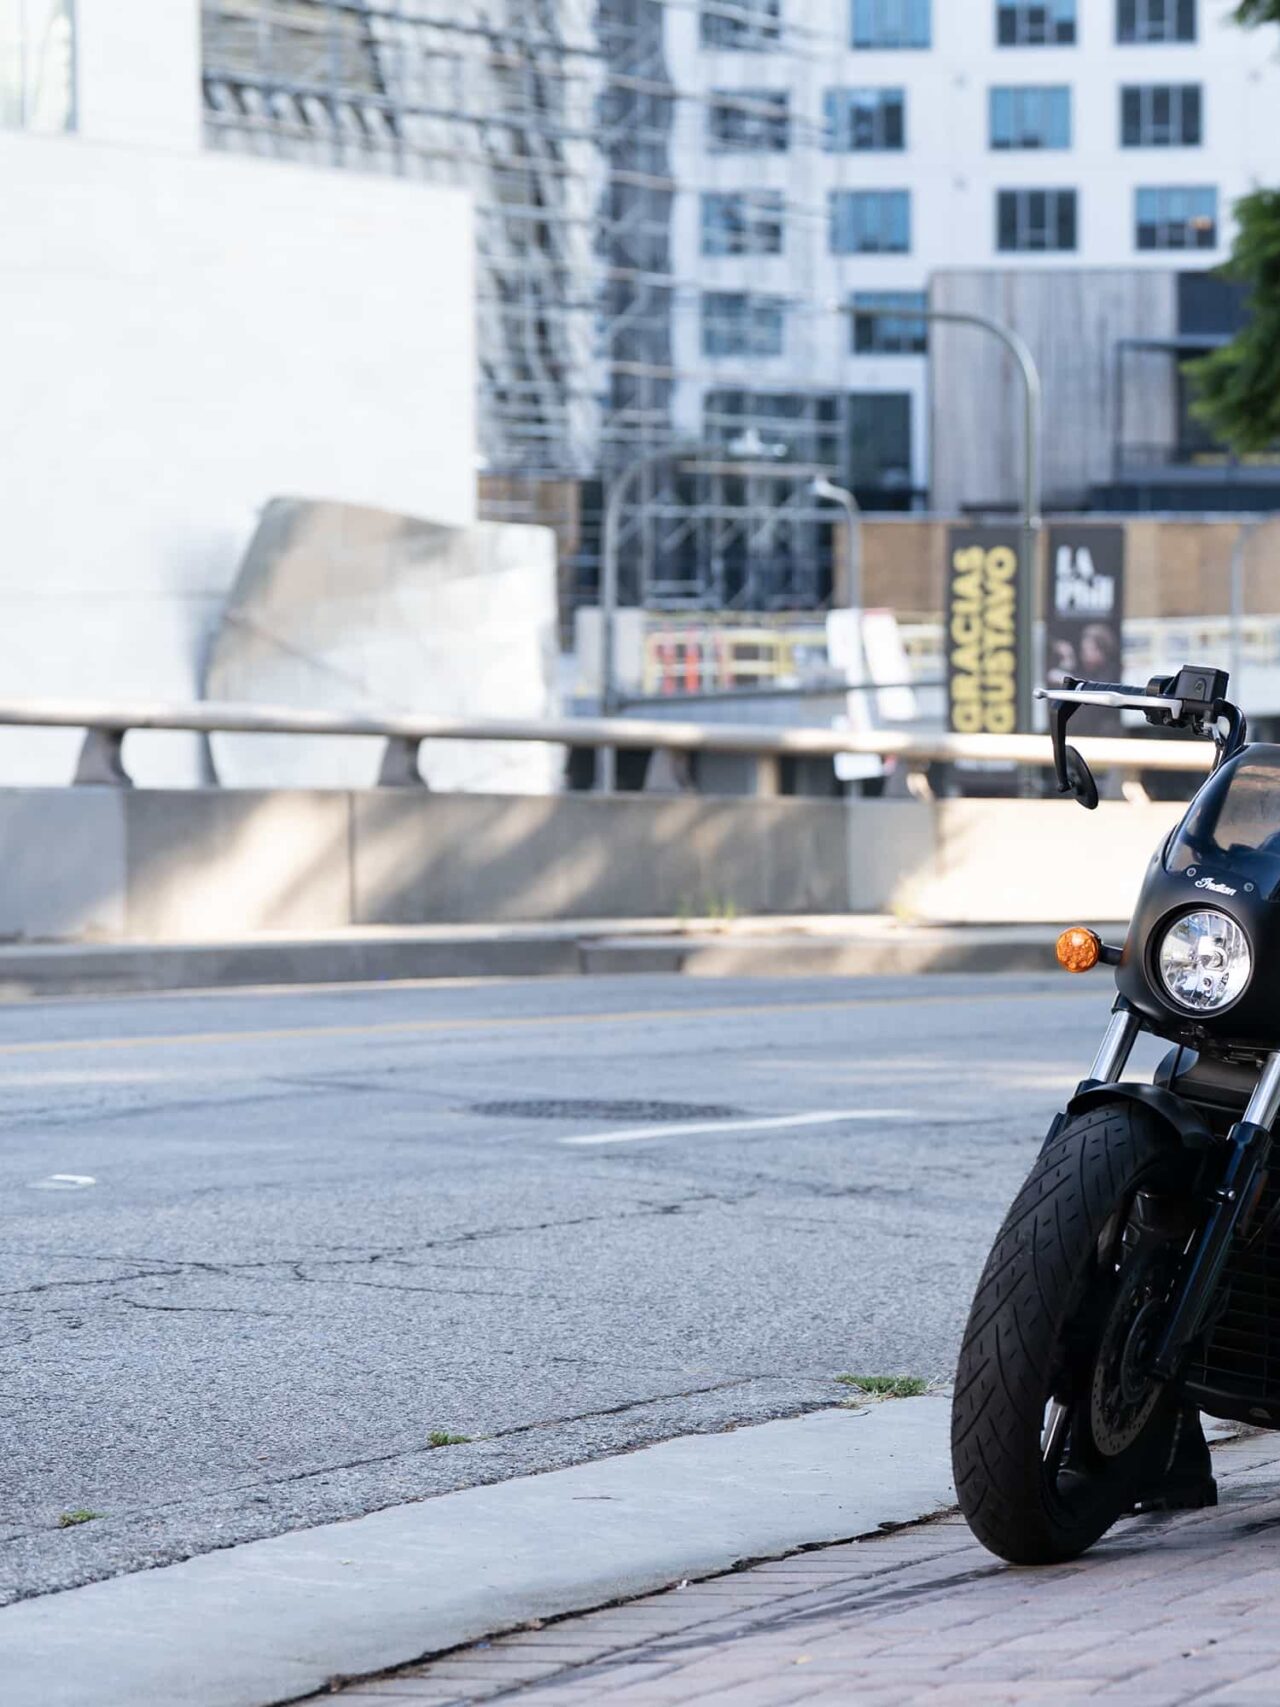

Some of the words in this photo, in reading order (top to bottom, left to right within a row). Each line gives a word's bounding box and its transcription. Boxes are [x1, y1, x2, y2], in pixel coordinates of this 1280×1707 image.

[951, 546, 985, 733] GRACIAS
[983, 546, 1016, 733] GUSTAVO
[1194, 876, 1238, 897] Indian
